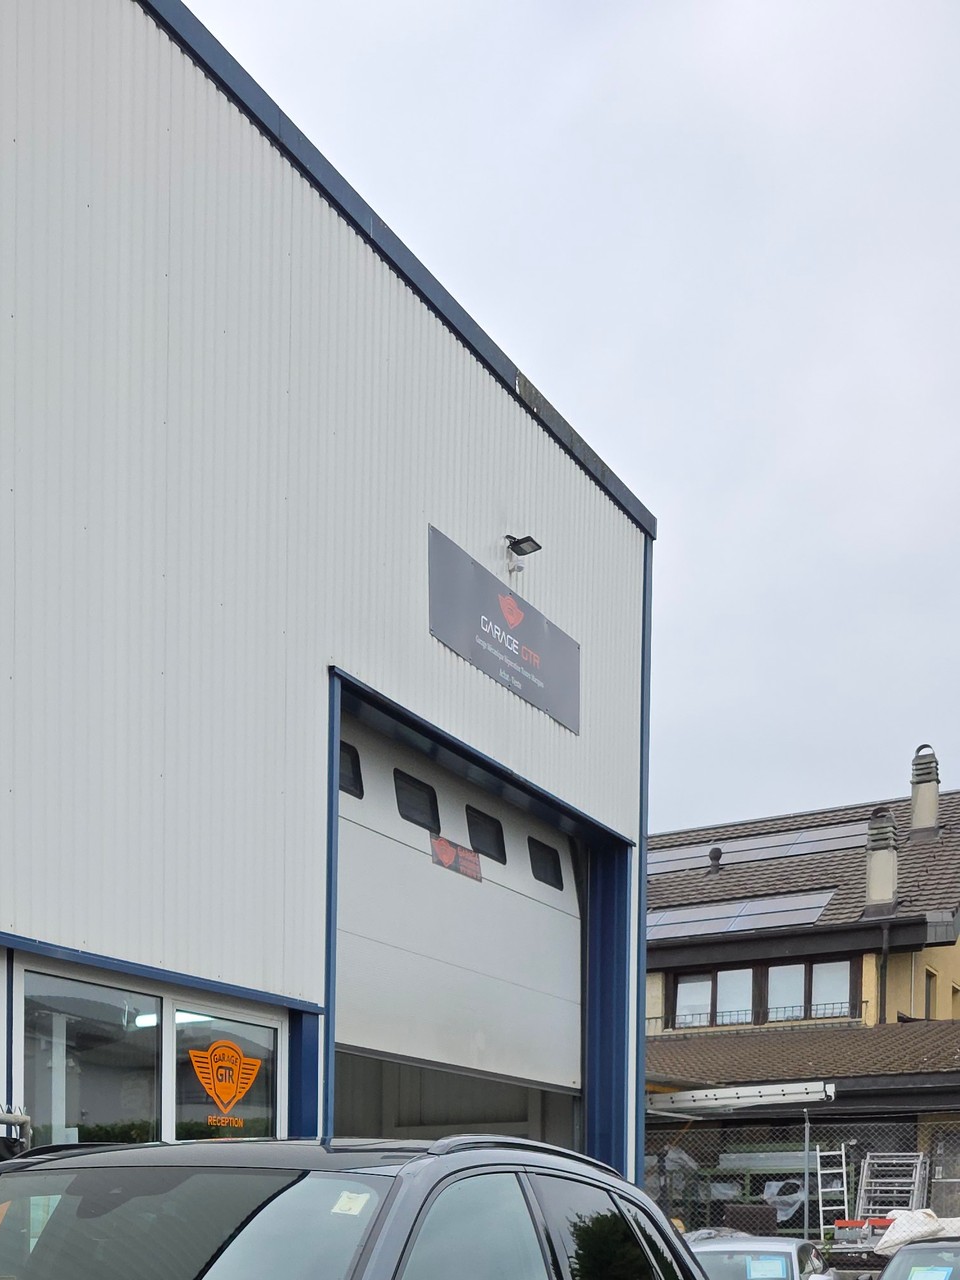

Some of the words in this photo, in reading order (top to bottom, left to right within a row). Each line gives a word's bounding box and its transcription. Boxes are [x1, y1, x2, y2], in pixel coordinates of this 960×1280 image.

[480, 615, 519, 655] GARAGE
[521, 645, 540, 669] GTR
[213, 1053, 239, 1067] GARAGE
[216, 1065, 235, 1084] GTR
